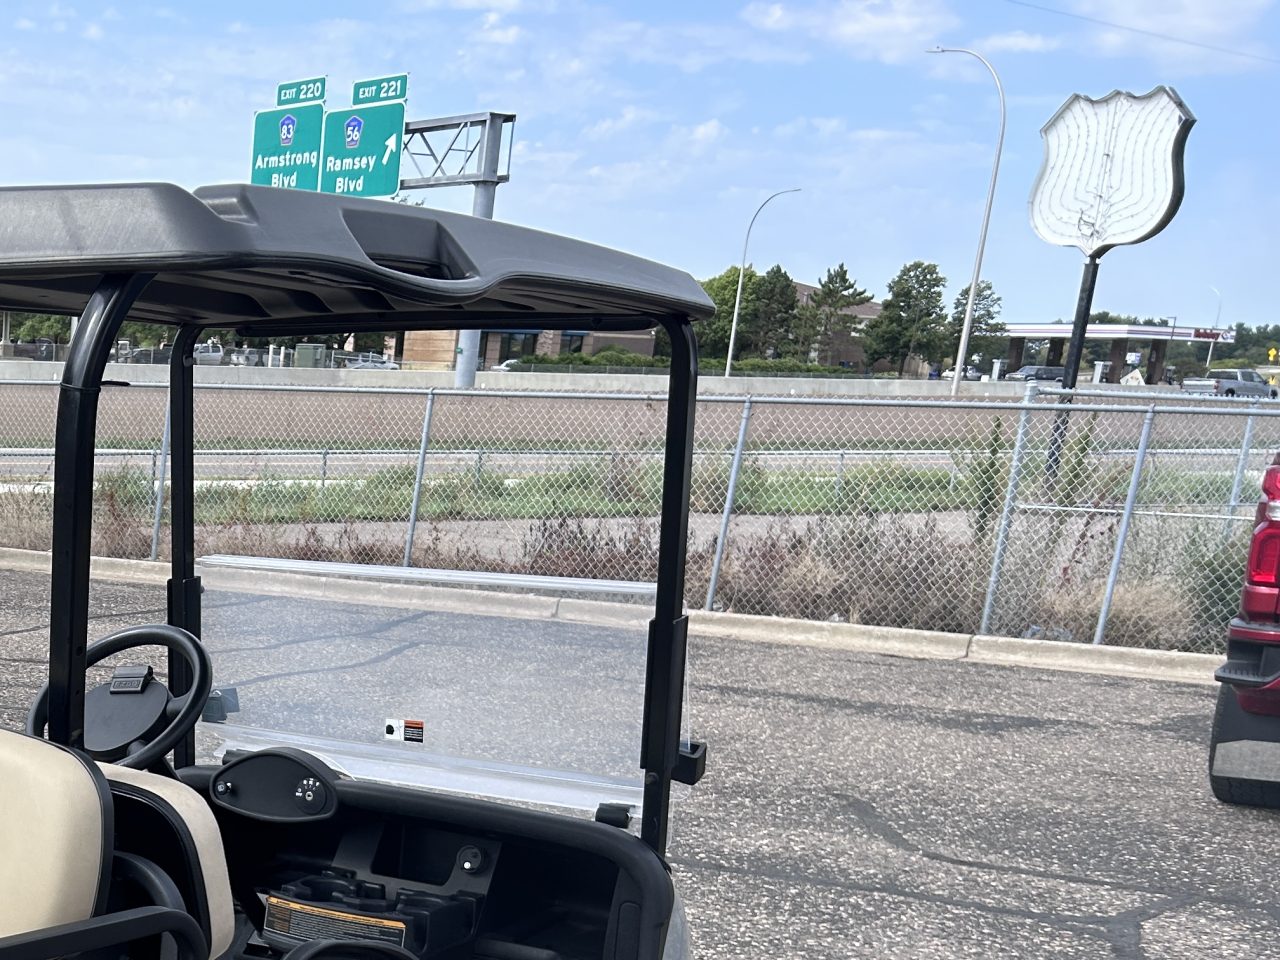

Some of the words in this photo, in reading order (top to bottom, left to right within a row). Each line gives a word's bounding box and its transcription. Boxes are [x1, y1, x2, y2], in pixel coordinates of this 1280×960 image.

[281, 88, 296, 99] EXIT
[299, 83, 321, 99] 220
[359, 86, 376, 99] EXIT
[380, 81, 401, 97] 221
[281, 125, 294, 139] 83
[346, 126, 360, 141] 56
[255, 150, 318, 169] Armstrong
[326, 154, 377, 173] Ramsey
[272, 172, 297, 188] Blvd
[336, 176, 363, 193] Blvd
